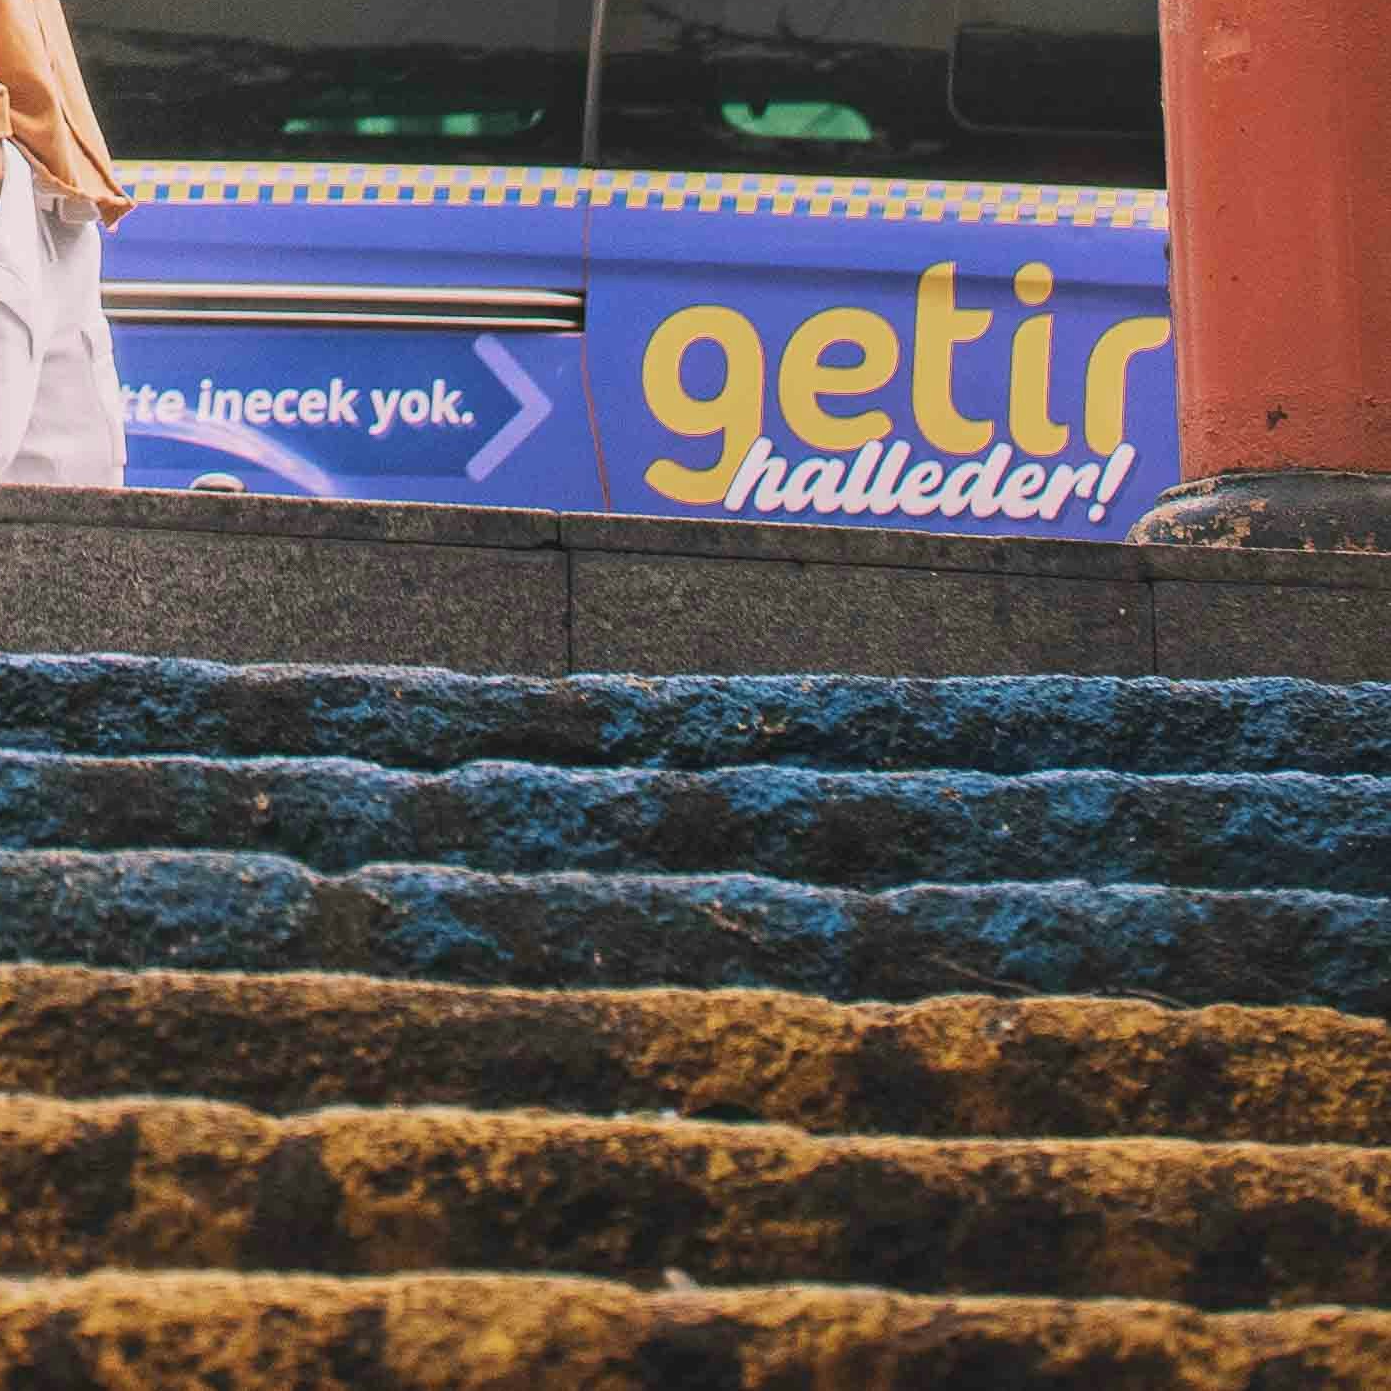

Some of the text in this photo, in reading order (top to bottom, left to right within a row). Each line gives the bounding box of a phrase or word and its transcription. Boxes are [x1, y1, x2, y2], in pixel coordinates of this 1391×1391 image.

[196, 378, 359, 425] inecek
[367, 378, 475, 436] yok.
[642, 261, 1172, 504] getir
[722, 435, 1136, 523] halleder!
